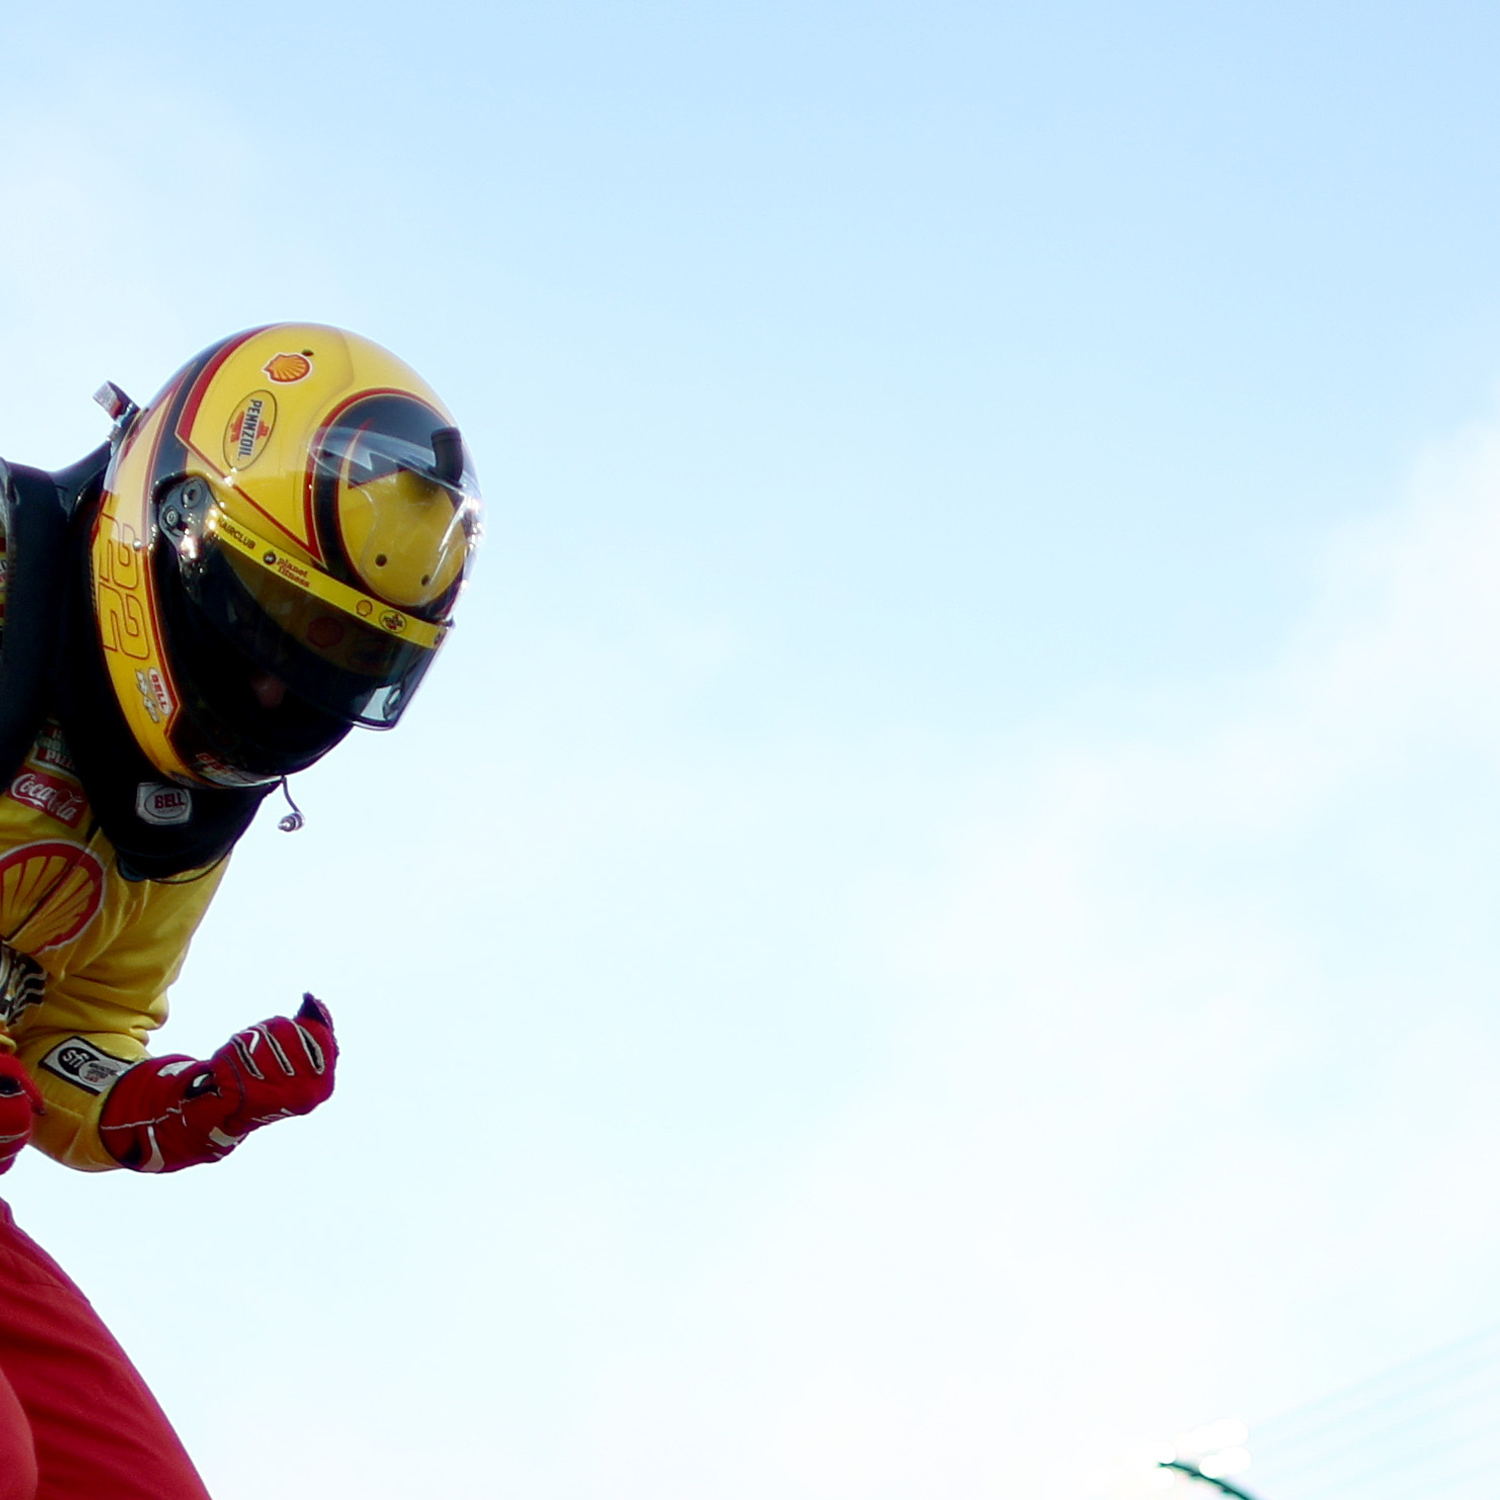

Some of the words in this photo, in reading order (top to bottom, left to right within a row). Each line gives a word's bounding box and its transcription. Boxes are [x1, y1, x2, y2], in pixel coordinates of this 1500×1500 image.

[237, 399, 263, 457] PENNZOIL
[150, 674, 169, 710] BELL
[154, 792, 186, 809] BELL
[62, 1049, 90, 1068] sfi
